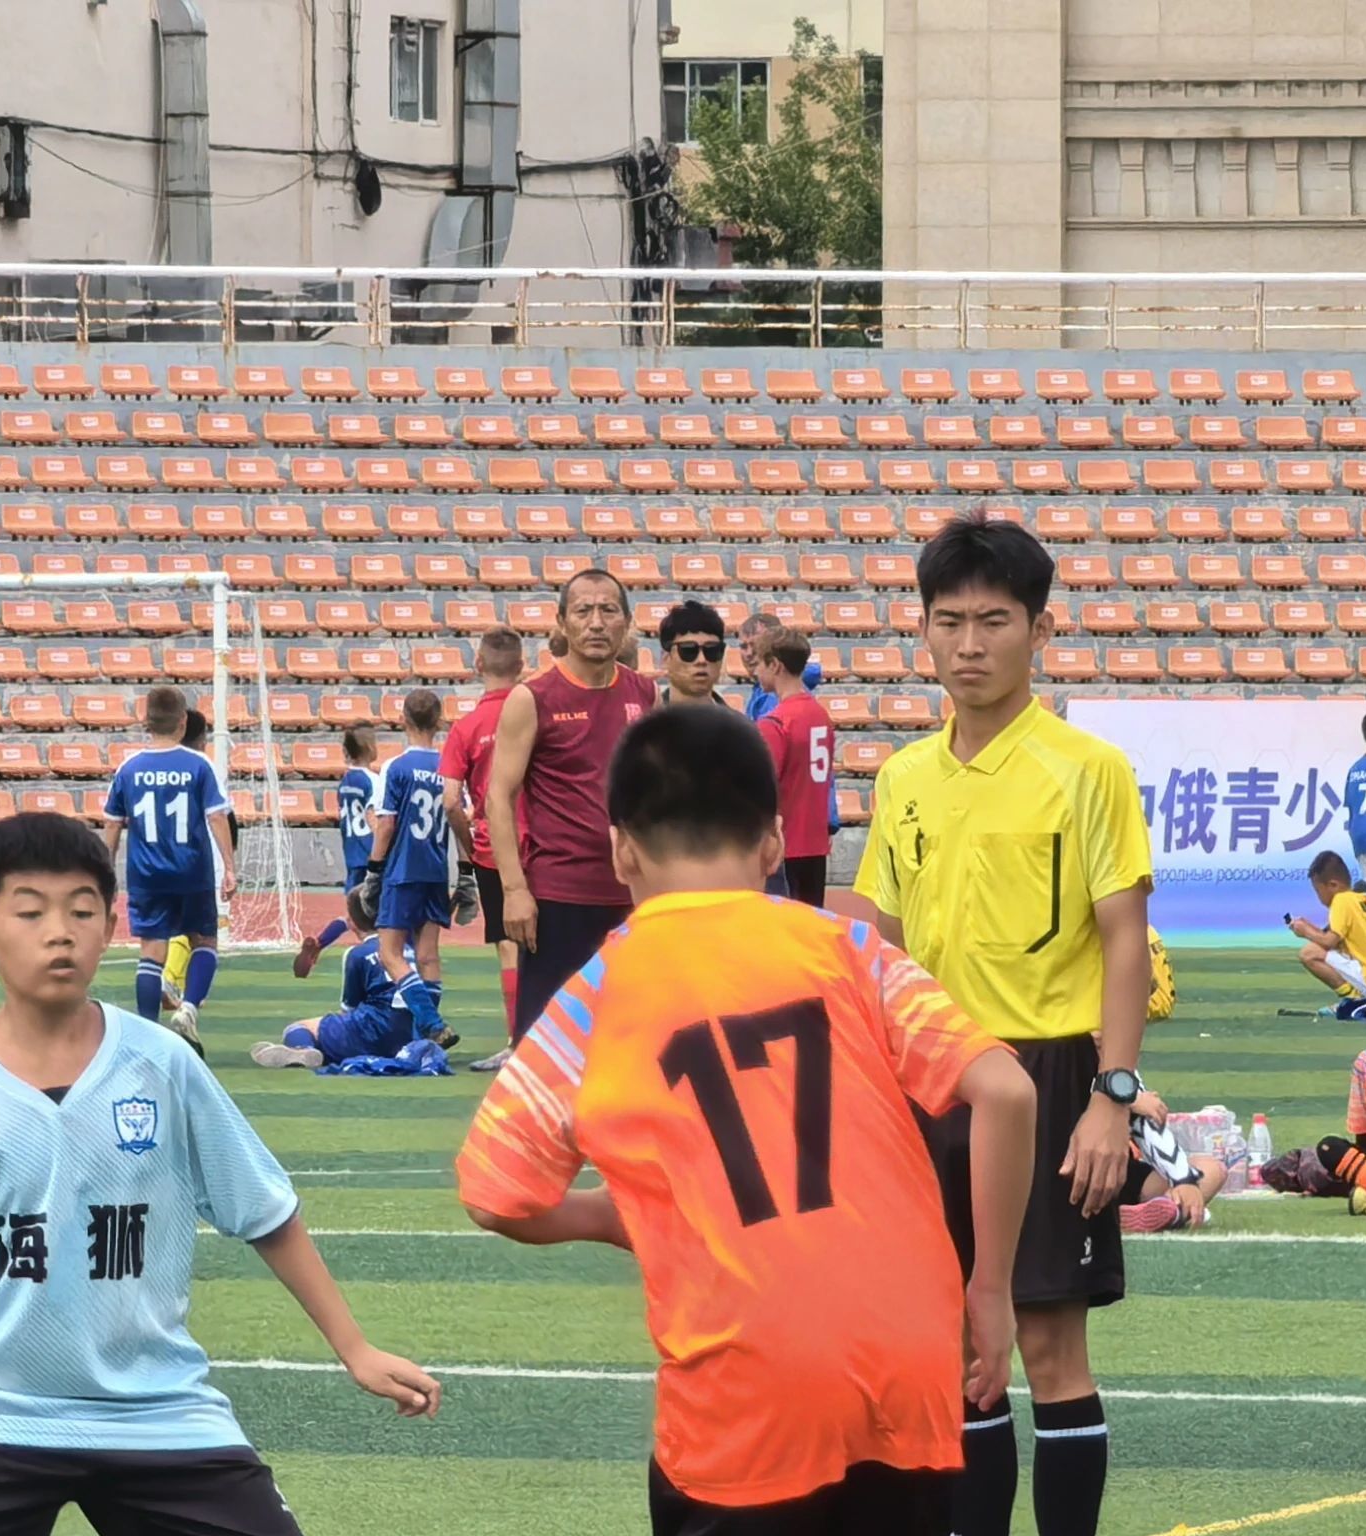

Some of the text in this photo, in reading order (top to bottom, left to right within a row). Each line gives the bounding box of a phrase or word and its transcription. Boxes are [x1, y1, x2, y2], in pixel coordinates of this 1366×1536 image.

[134, 770, 192, 787] ГОВОР
[809, 726, 830, 783] 5
[133, 790, 189, 844] 11
[340, 798, 372, 838] 18
[656, 996, 835, 1228] 17
